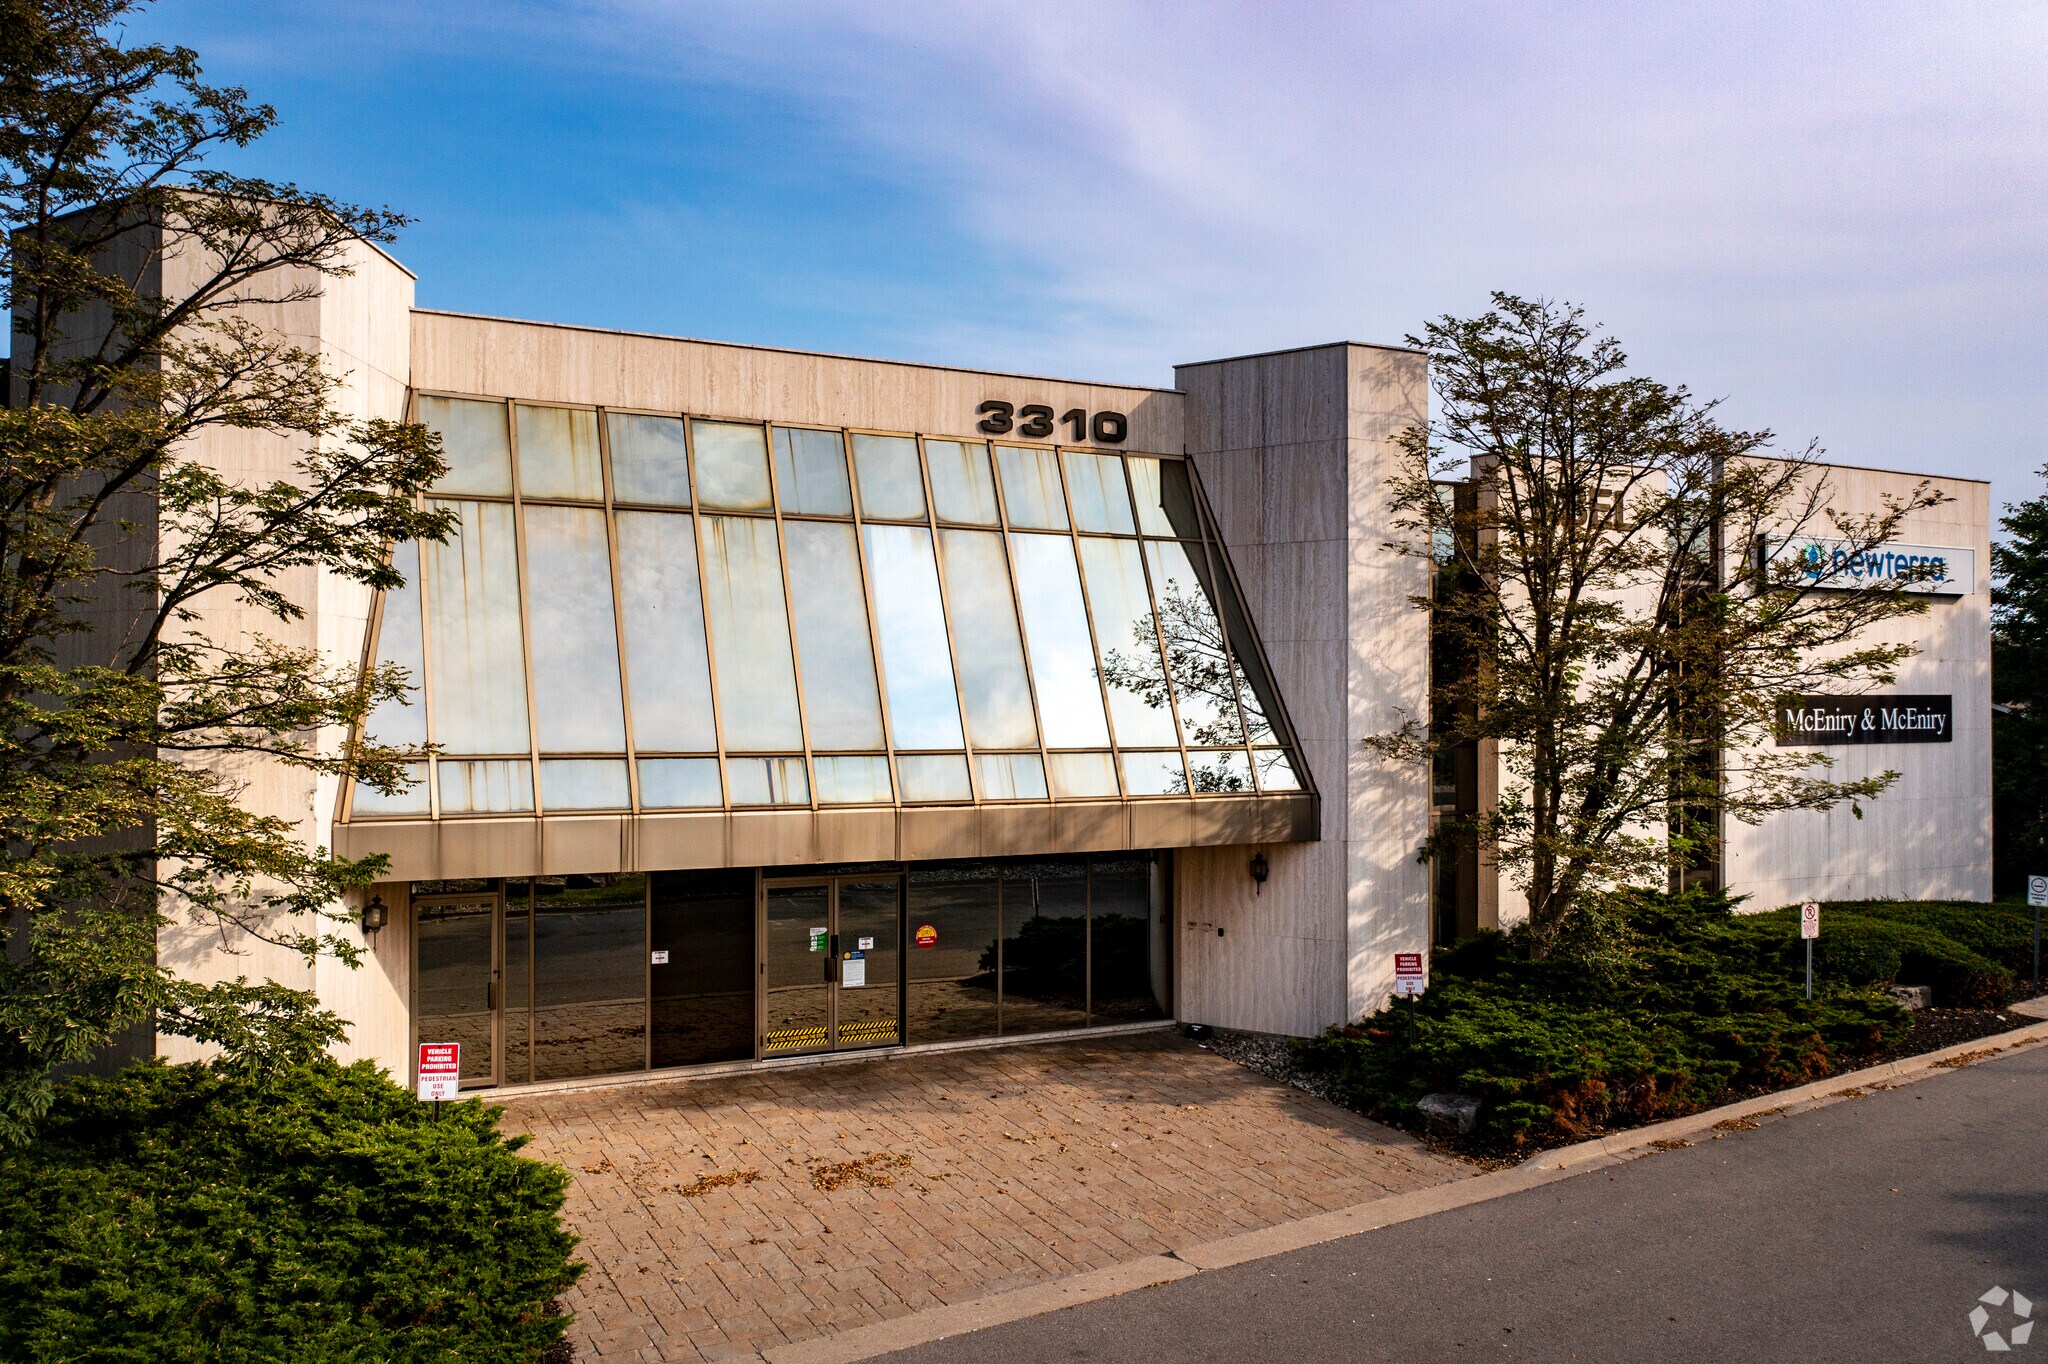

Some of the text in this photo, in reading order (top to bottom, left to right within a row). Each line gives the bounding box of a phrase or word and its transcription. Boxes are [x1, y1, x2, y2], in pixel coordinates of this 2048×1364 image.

[979, 400, 1128, 443] 3310
[1785, 707, 1946, 737] McEniry & McEniry
